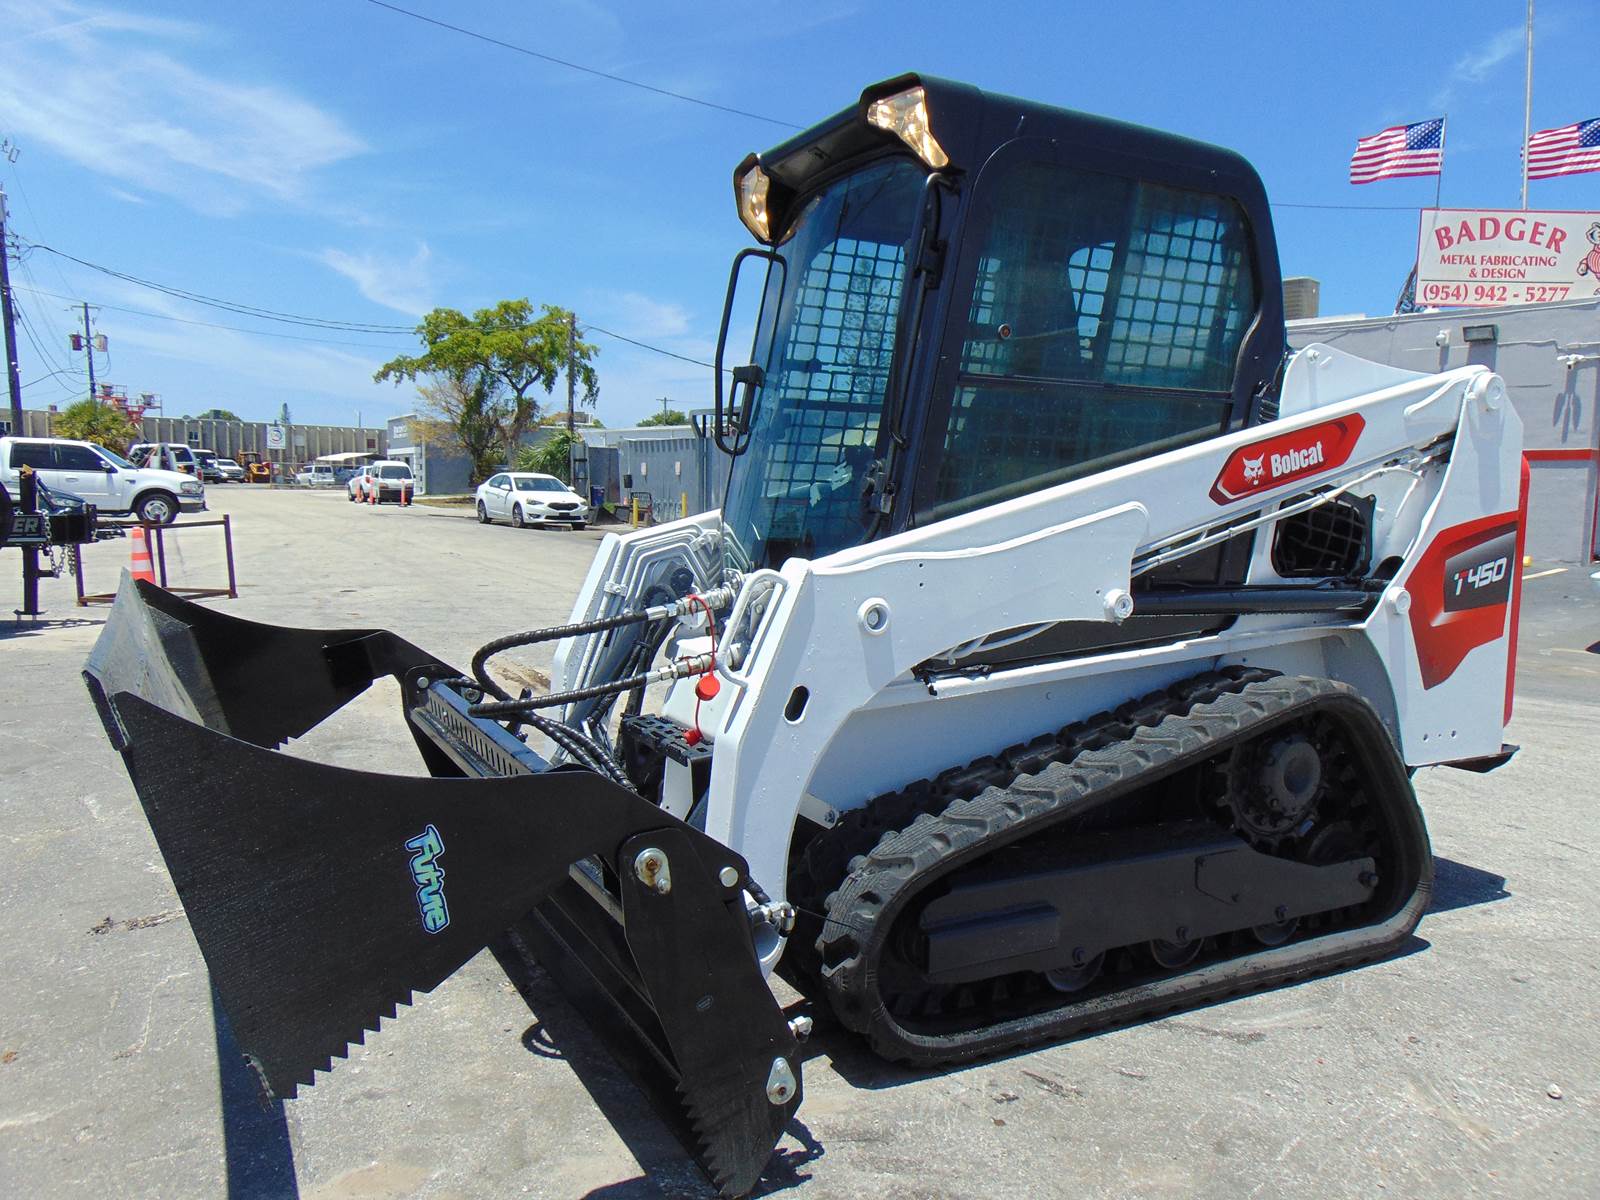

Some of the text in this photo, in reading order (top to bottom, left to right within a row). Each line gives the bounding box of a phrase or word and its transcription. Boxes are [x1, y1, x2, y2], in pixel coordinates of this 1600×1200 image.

[1435, 217, 1567, 254] BADGER
[1440, 255, 1557, 267] METAL FABRICATING
[1469, 268, 1526, 279] & DESIGN
[1423, 284, 1469, 302] (954)
[1474, 285, 1508, 301] 942
[1525, 286, 1570, 302] 5277
[1270, 441, 1324, 478] Bobcat
[1454, 557, 1507, 596] T450
